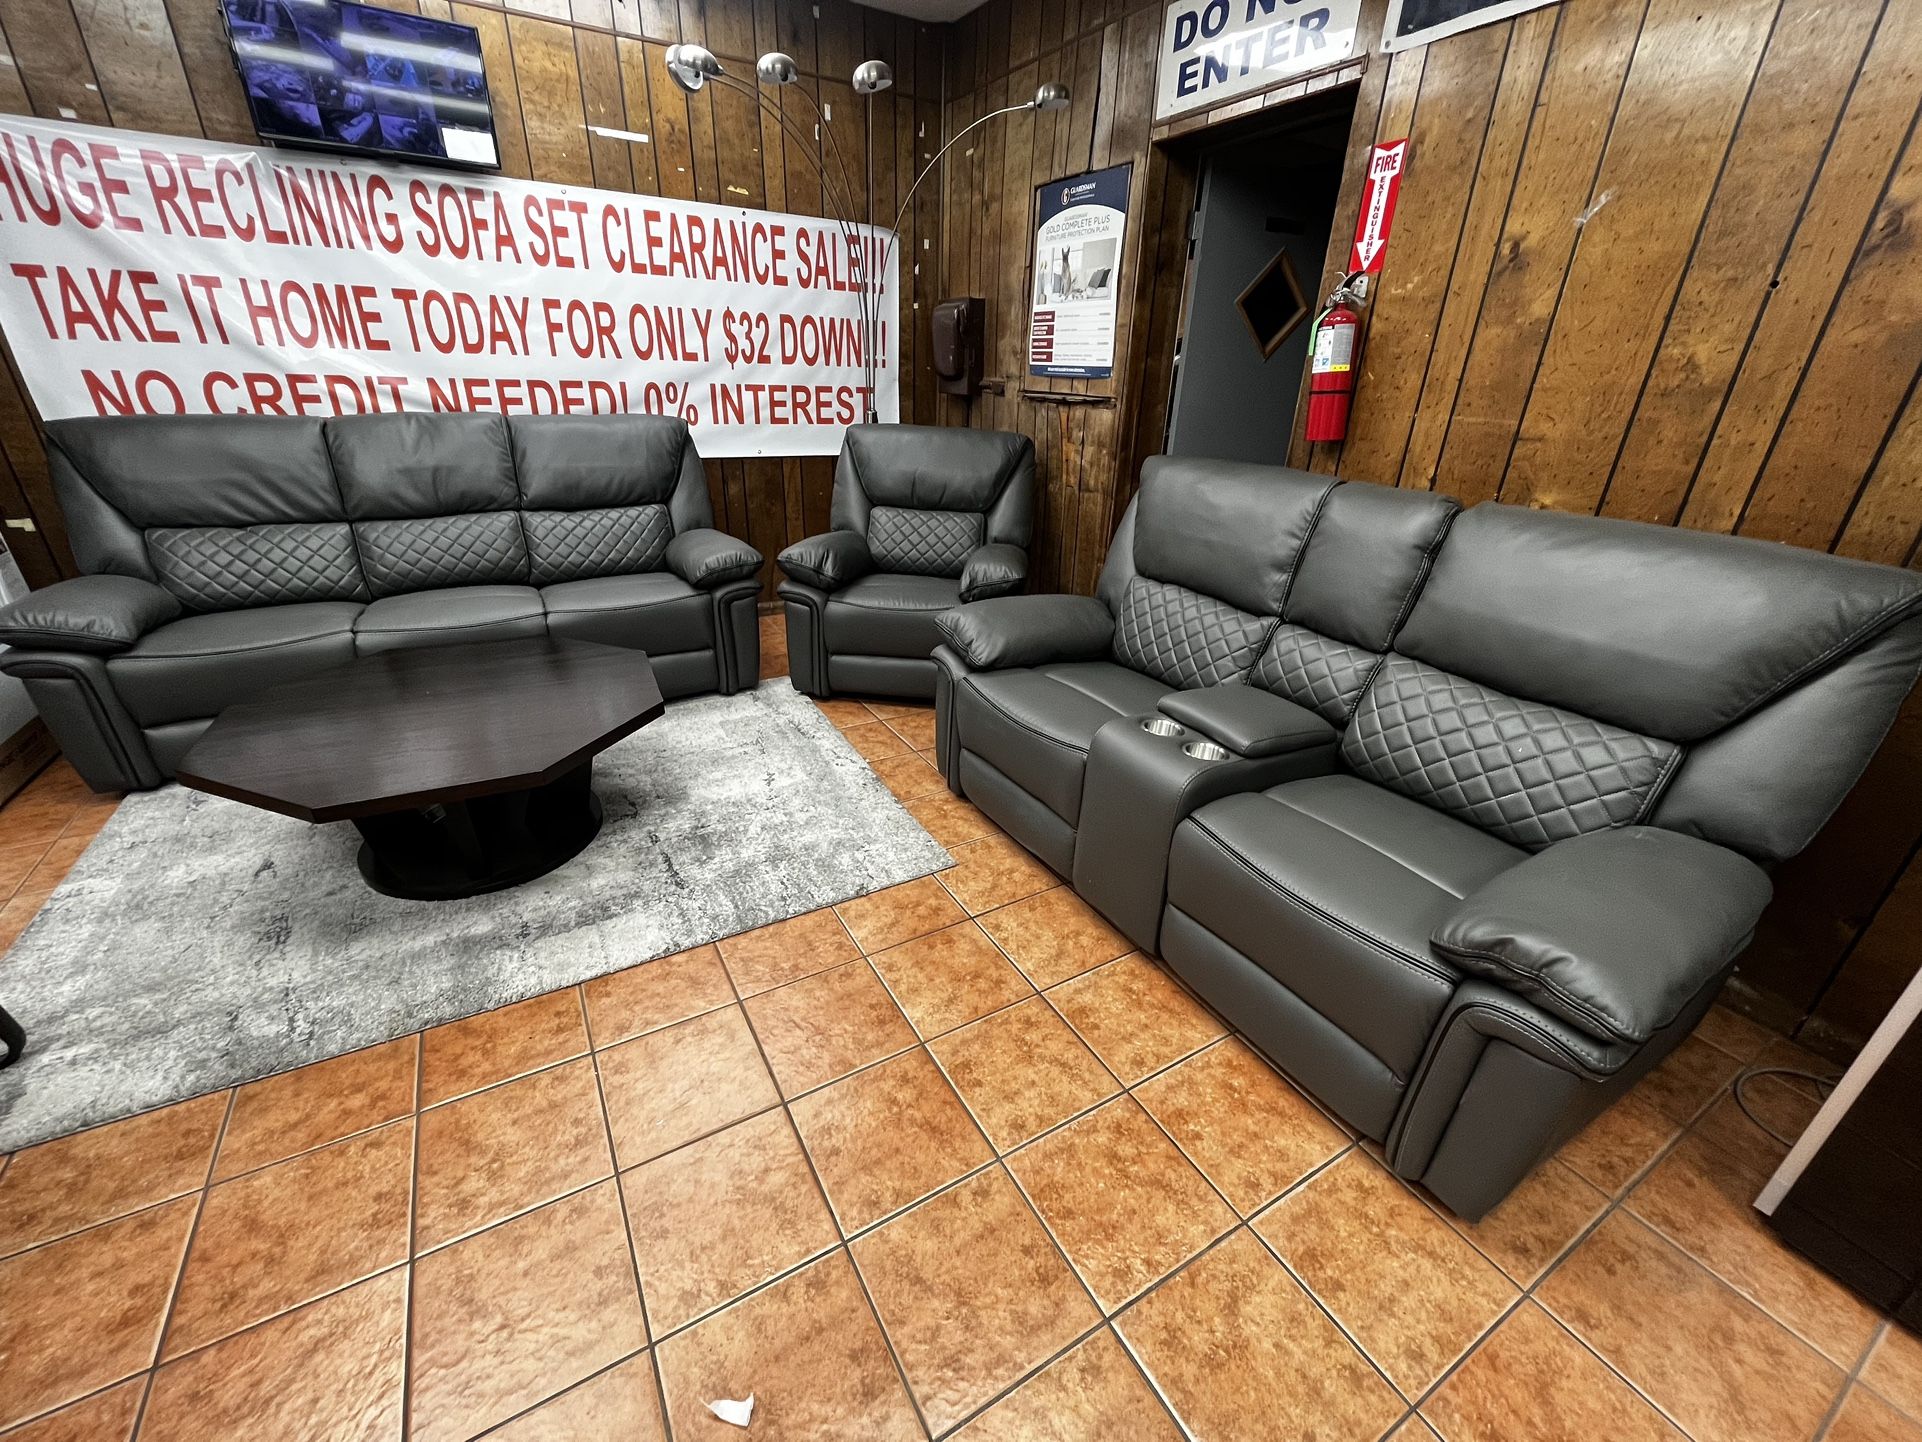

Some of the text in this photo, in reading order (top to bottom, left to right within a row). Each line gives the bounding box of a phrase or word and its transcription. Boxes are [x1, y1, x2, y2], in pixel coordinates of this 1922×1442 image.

[1173, 0, 1230, 53] DO
[1177, 8, 1330, 98] ENTER
[1373, 152, 1400, 175] FIRE
[0, 132, 885, 295] HUGE RECLINING SOFA SET CLEARANCE SALE!!!
[1046, 214, 1111, 235] GOLD COMPLETE PLUS
[1067, 228, 1095, 238] PROTECTION
[1095, 225, 1110, 233] PLAN
[1363, 175, 1387, 262] EXTINGUISHER
[10, 263, 180, 343] TAKE
[177, 273, 230, 345] IT
[239, 277, 391, 352] HOME
[392, 288, 530, 356] TODAY
[542, 298, 622, 360] FOR
[628, 303, 712, 362] ONLY
[723, 306, 771, 369] $32
[81, 369, 186, 416] NO
[202, 371, 409, 416] CREDIT
[643, 381, 699, 427] 0%
[710, 382, 876, 425] INTEREST
